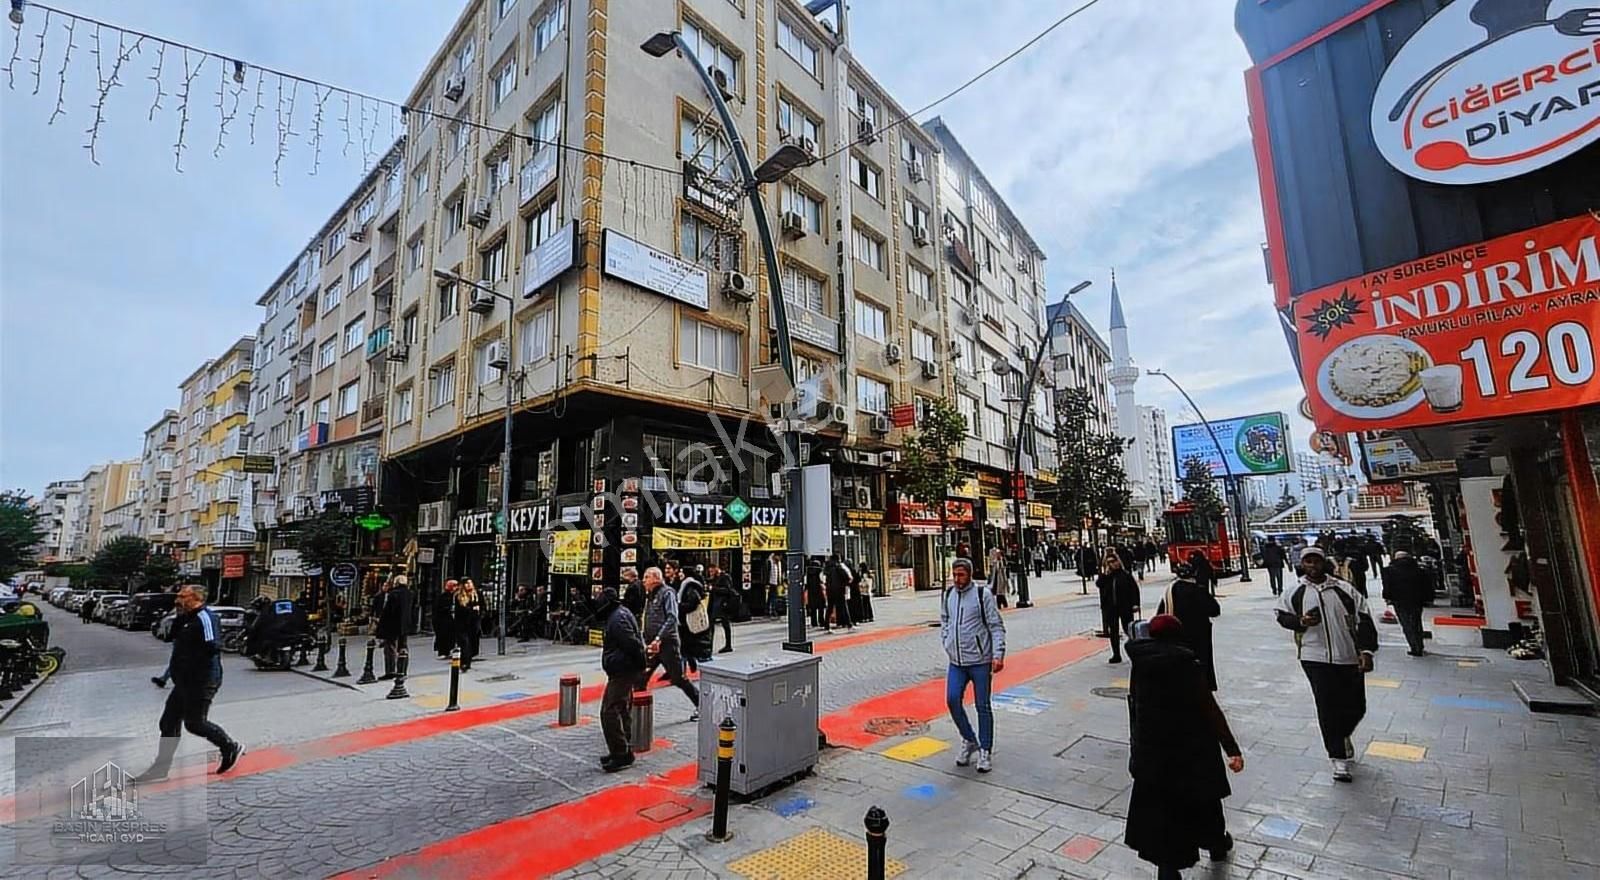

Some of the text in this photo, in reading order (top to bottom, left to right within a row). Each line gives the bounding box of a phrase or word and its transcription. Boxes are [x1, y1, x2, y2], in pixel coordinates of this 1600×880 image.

[1372, 272, 1389, 286] AY
[1399, 315, 1471, 339] TAVUKLU
[1546, 288, 1600, 312] AYRA
[1459, 319, 1596, 398] 120
[458, 509, 493, 536] KÖFTE
[664, 496, 724, 525] KÖFTE
